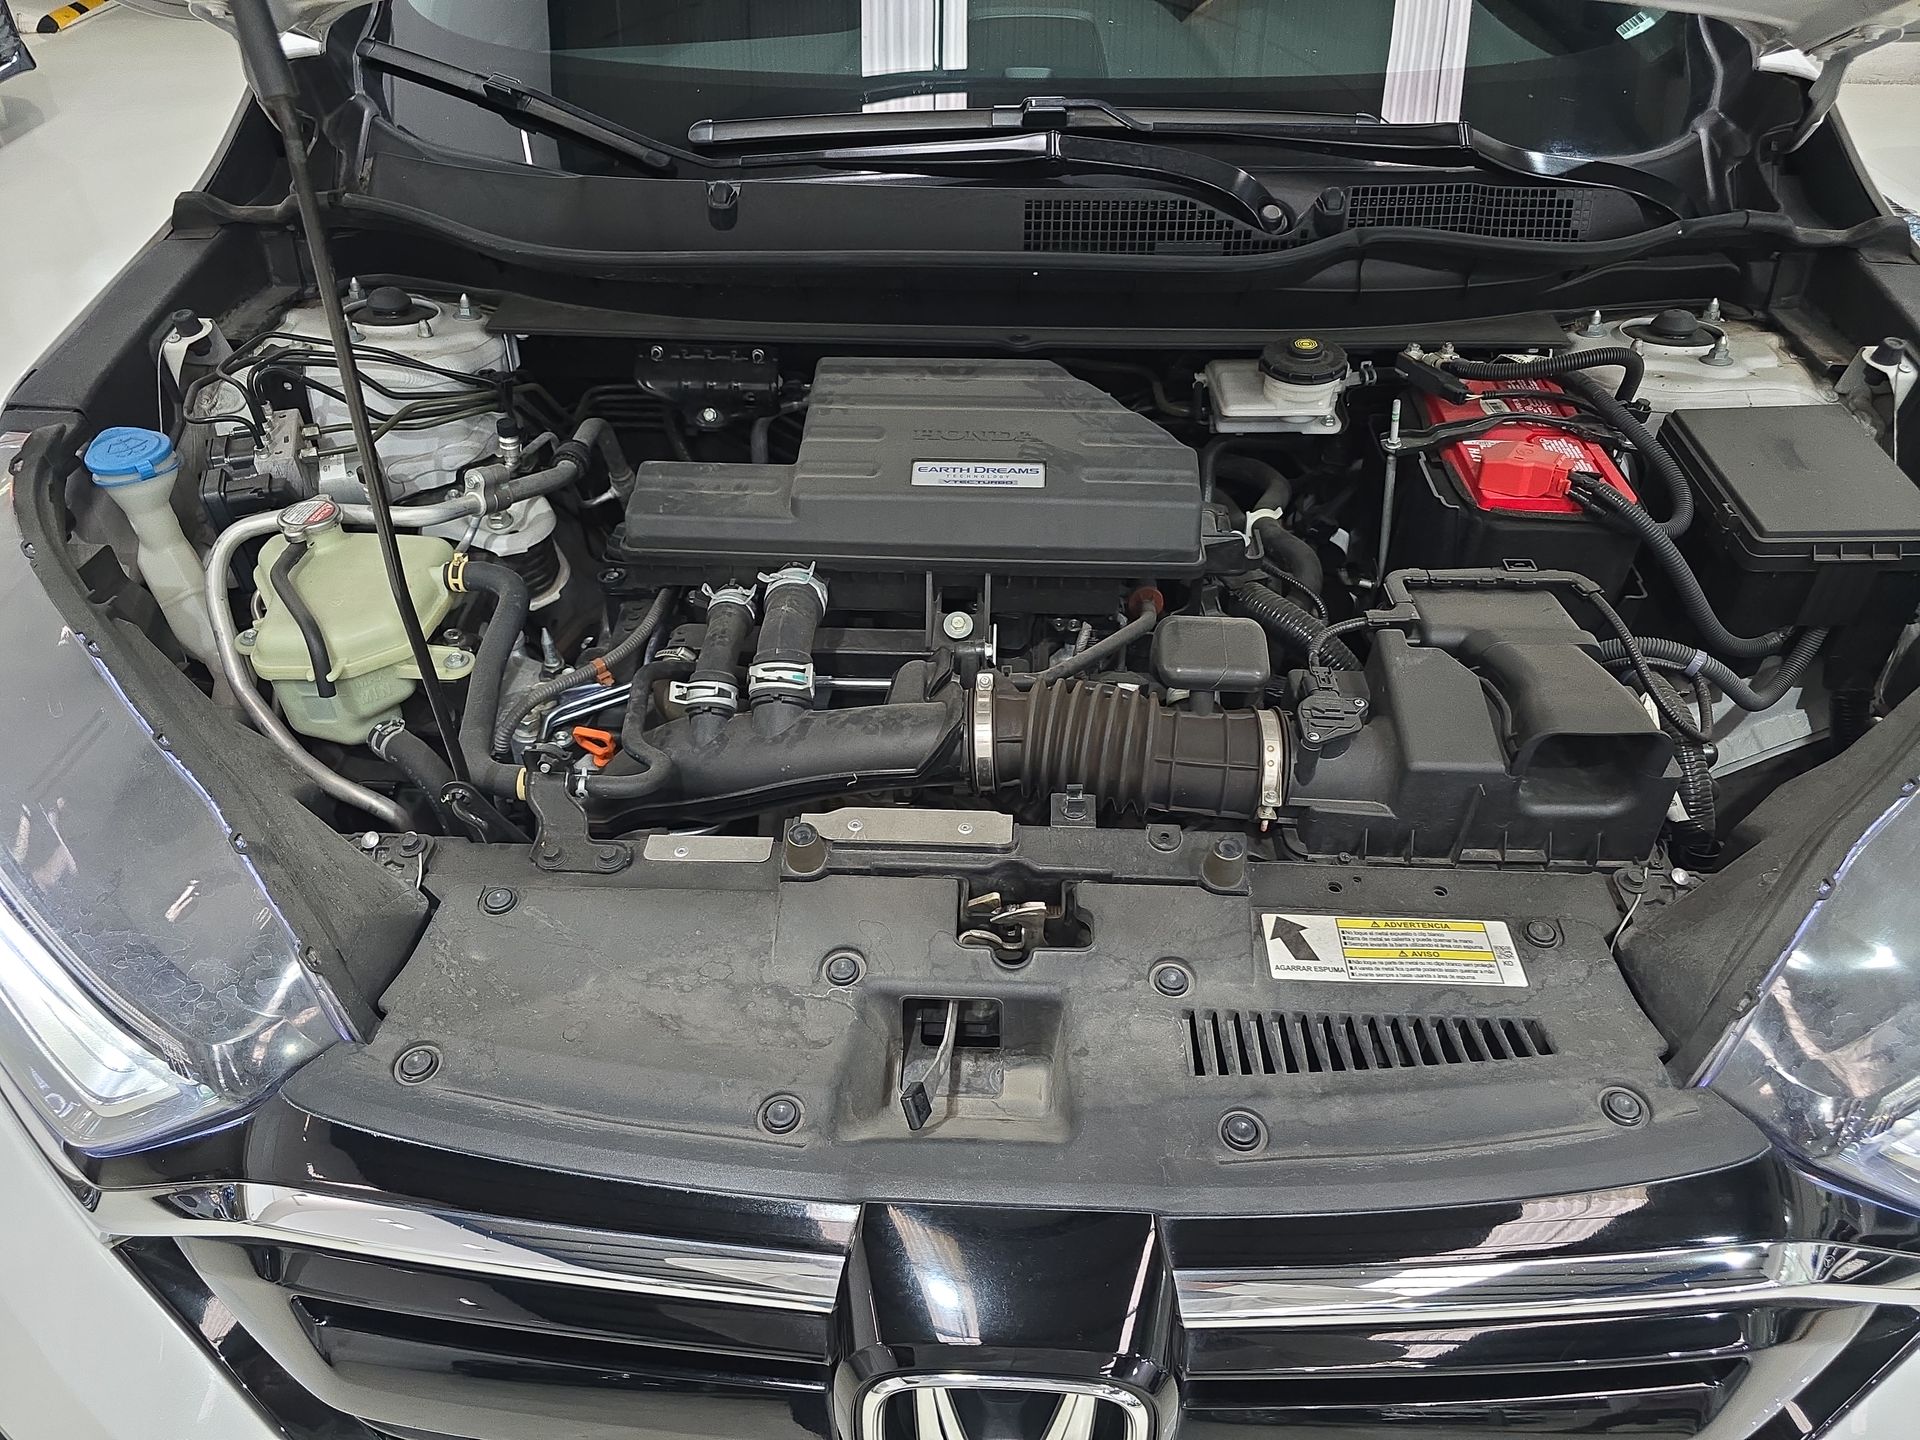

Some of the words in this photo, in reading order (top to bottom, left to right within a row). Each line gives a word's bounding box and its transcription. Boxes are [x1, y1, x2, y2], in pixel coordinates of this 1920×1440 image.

[913, 430, 1044, 442] HONDA
[917, 466, 970, 474] EARTH
[974, 466, 1040, 475] DREAMS
[1383, 921, 1450, 929] ADVERTENCIA
